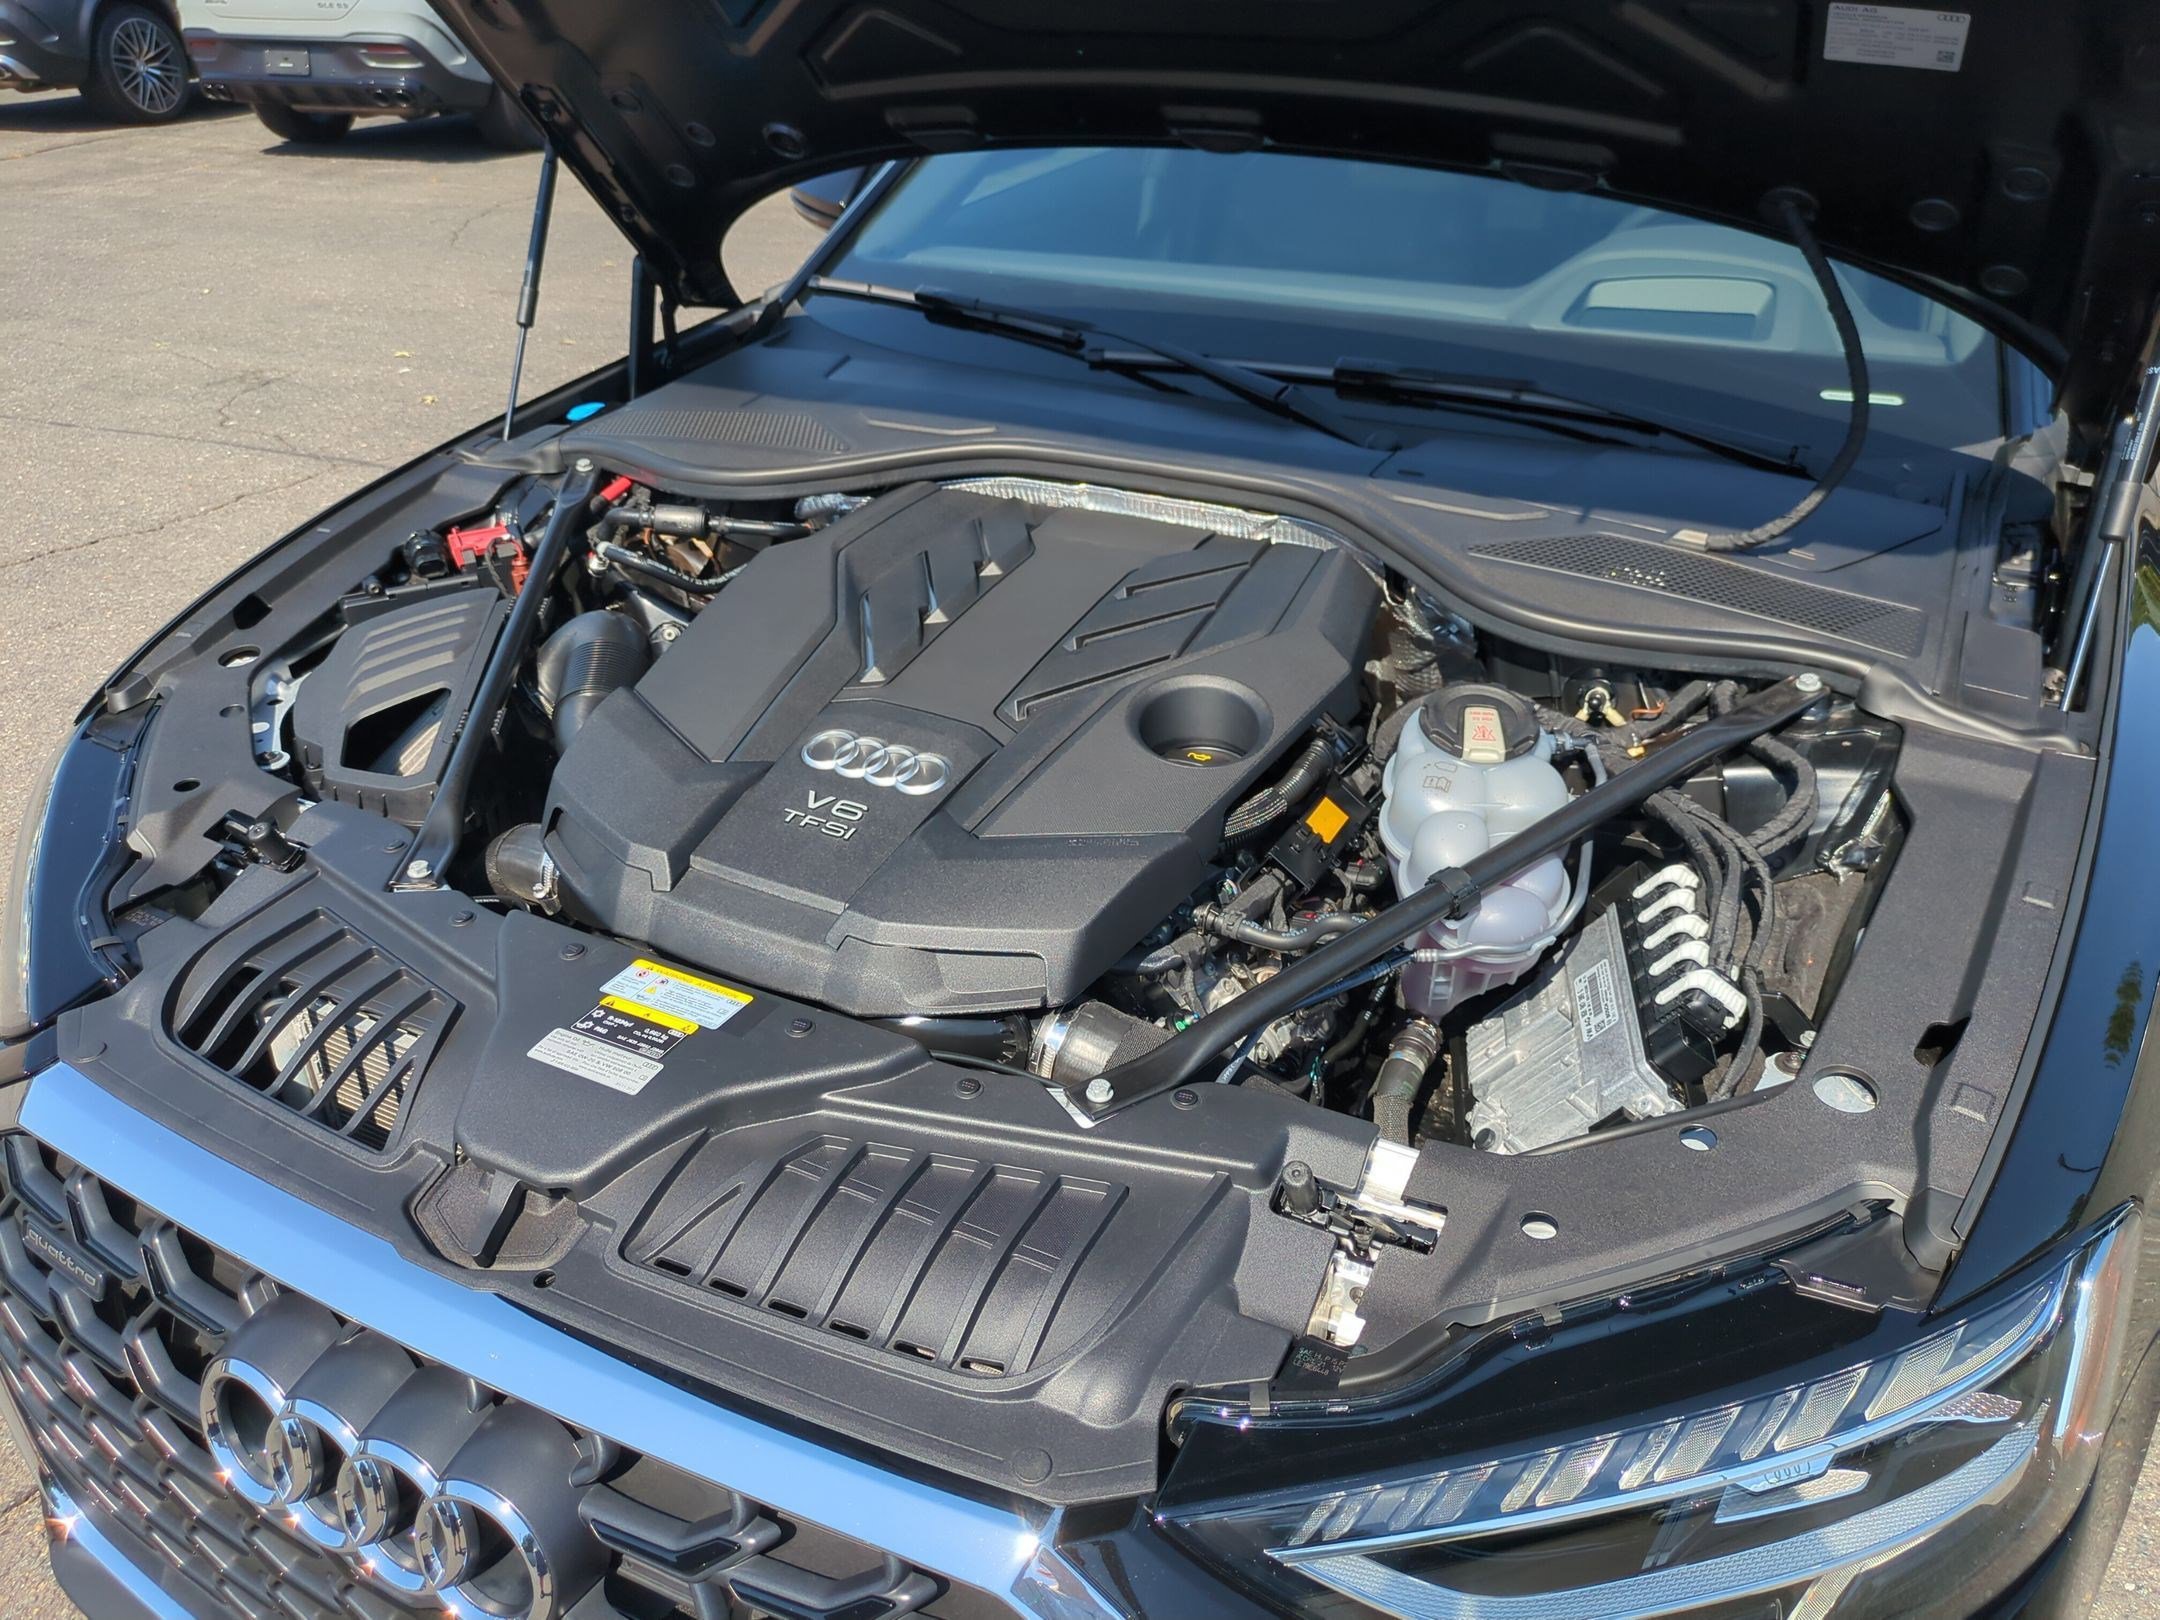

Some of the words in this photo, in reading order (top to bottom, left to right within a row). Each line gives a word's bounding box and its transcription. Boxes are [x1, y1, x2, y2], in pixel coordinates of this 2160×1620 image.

[807, 789, 869, 822] V6
[783, 807, 857, 841] TFSI
[28, 1228, 96, 1287] quattro
